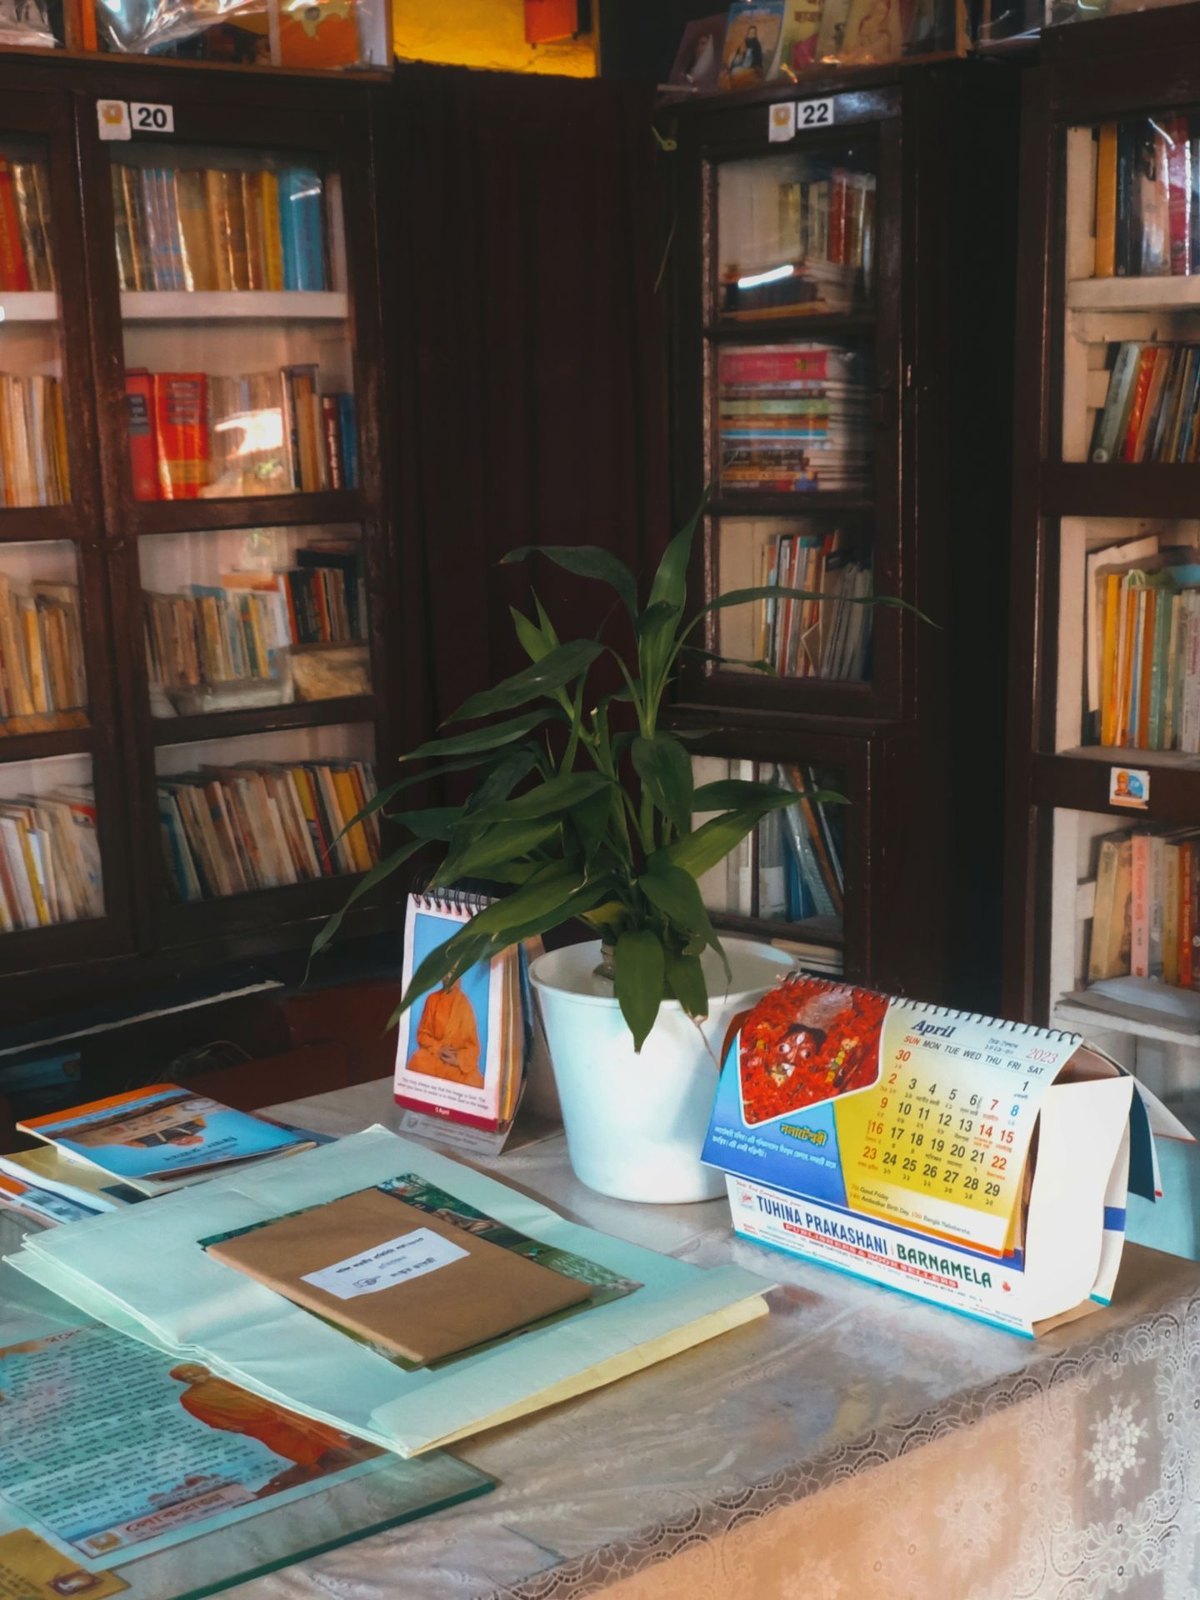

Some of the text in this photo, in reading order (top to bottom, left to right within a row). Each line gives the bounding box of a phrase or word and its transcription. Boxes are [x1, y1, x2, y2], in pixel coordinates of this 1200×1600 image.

[138, 107, 167, 128] 20
[803, 103, 828, 125] 22
[911, 1020, 956, 1038] April
[895, 1050, 1029, 1092] 30 1
[904, 1035, 1044, 1075] SUN MON TUE WED THU FRI SAT
[1025, 1048, 1058, 1064] 2023
[889, 1073, 897, 1084] 2
[909, 1079, 917, 1090] 3
[928, 1084, 937, 1095] 4
[948, 1089, 957, 1100] 5
[969, 1094, 978, 1106] 6
[990, 1099, 999, 1110] 7
[1010, 1105, 1019, 1117] 8
[880, 1097, 888, 1108] 9
[898, 1102, 911, 1115] 10
[918, 1107, 930, 1120] 11
[938, 1112, 952, 1126] 12
[959, 1119, 973, 1132] 13
[979, 1124, 993, 1138] 14
[1000, 1130, 1014, 1143] 15
[870, 1121, 884, 1135] 16
[891, 1126, 905, 1140] 17
[910, 1132, 924, 1146] 18
[931, 1138, 945, 1152] 19
[950, 1144, 966, 1158] 20
[970, 1150, 985, 1164] 21
[991, 1155, 1007, 1170] 22
[863, 1146, 877, 1160] 23
[883, 1151, 897, 1166] 24
[902, 1158, 917, 1172] 25
[923, 1164, 938, 1178] 26
[943, 1170, 959, 1184] 27
[964, 1176, 979, 1190] 28
[984, 1182, 1000, 1197] 29
[756, 1195, 802, 1226] TUHINA
[805, 1213, 888, 1256] PRAKASHANI
[896, 1243, 992, 1289] BARNAMELA
[786, 1223, 857, 1253] PUBLISHERS
[868, 1253, 898, 1269] BOOK
[900, 1263, 958, 1287] SELLERS
